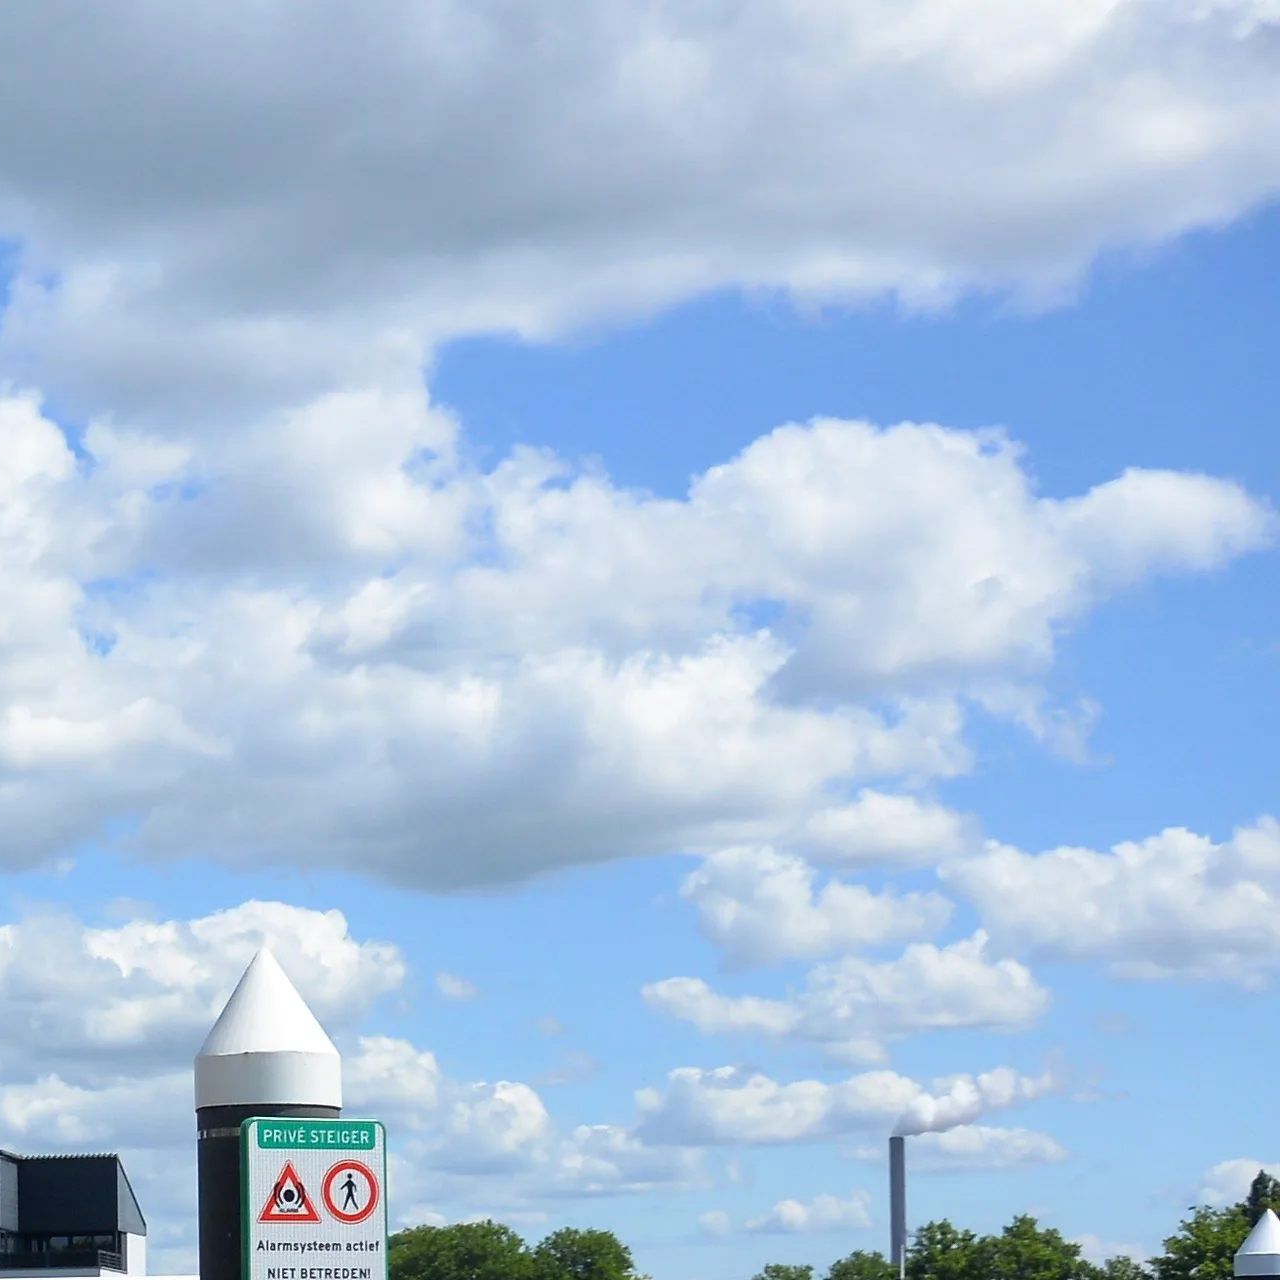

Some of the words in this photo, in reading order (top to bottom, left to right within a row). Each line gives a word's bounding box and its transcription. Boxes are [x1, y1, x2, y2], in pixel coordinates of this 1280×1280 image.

[262, 1126, 306, 1143] PRIVÉ
[310, 1129, 370, 1145] STEIGER
[256, 1239, 342, 1254] Alarmsysteem
[345, 1240, 380, 1252] actief
[267, 1267, 296, 1280] NIET
[300, 1267, 371, 1280] BETREDEN!
